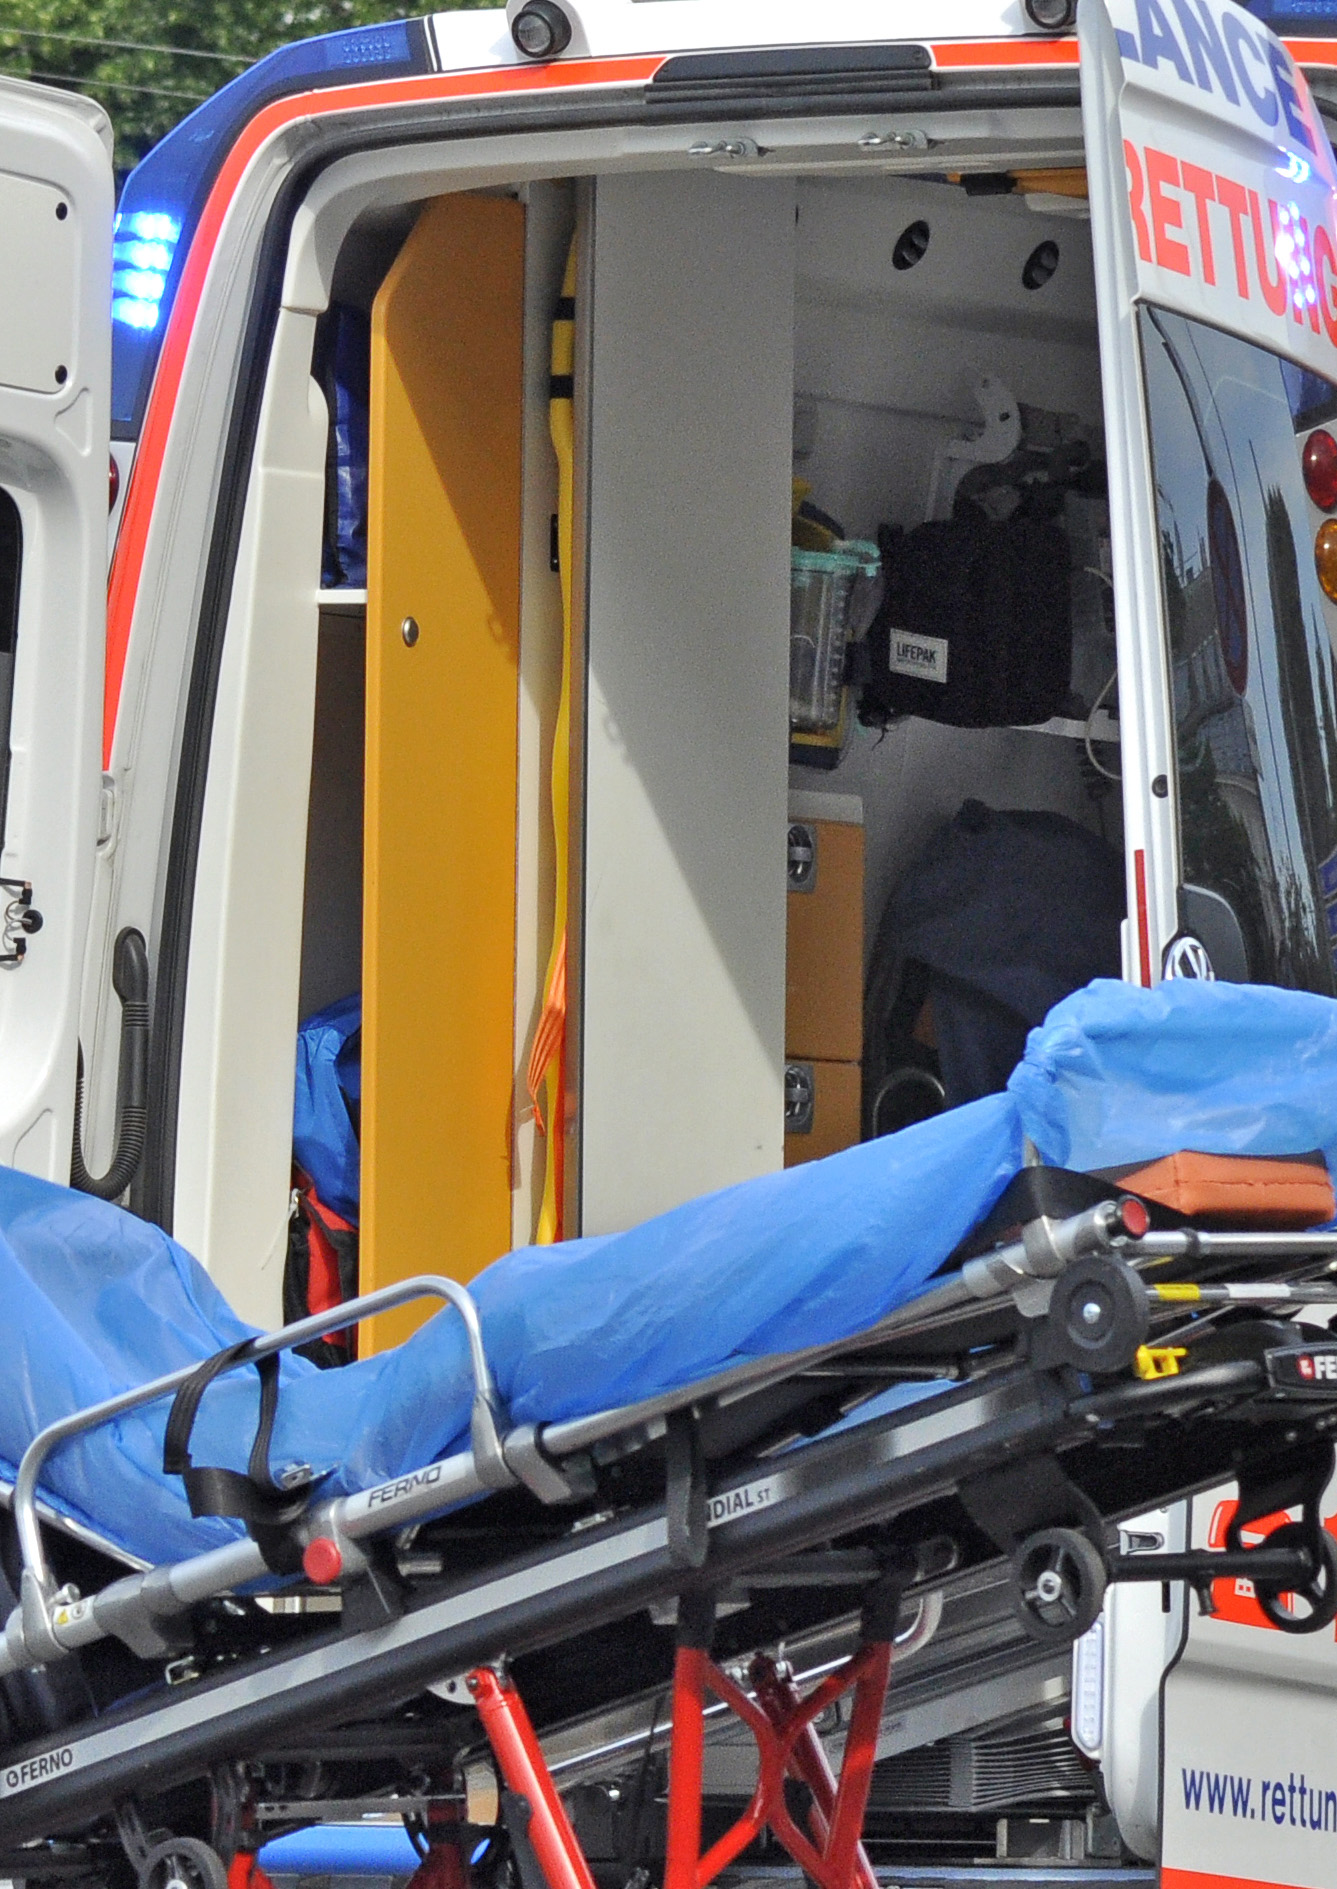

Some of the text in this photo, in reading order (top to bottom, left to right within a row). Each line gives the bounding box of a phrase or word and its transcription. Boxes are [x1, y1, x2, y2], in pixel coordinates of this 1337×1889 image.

[896, 641, 936, 664] LIFEPAK
[368, 1466, 442, 1507] FERNO
[707, 1488, 770, 1521] DIAL ST
[21, 1748, 74, 1785] FERNO
